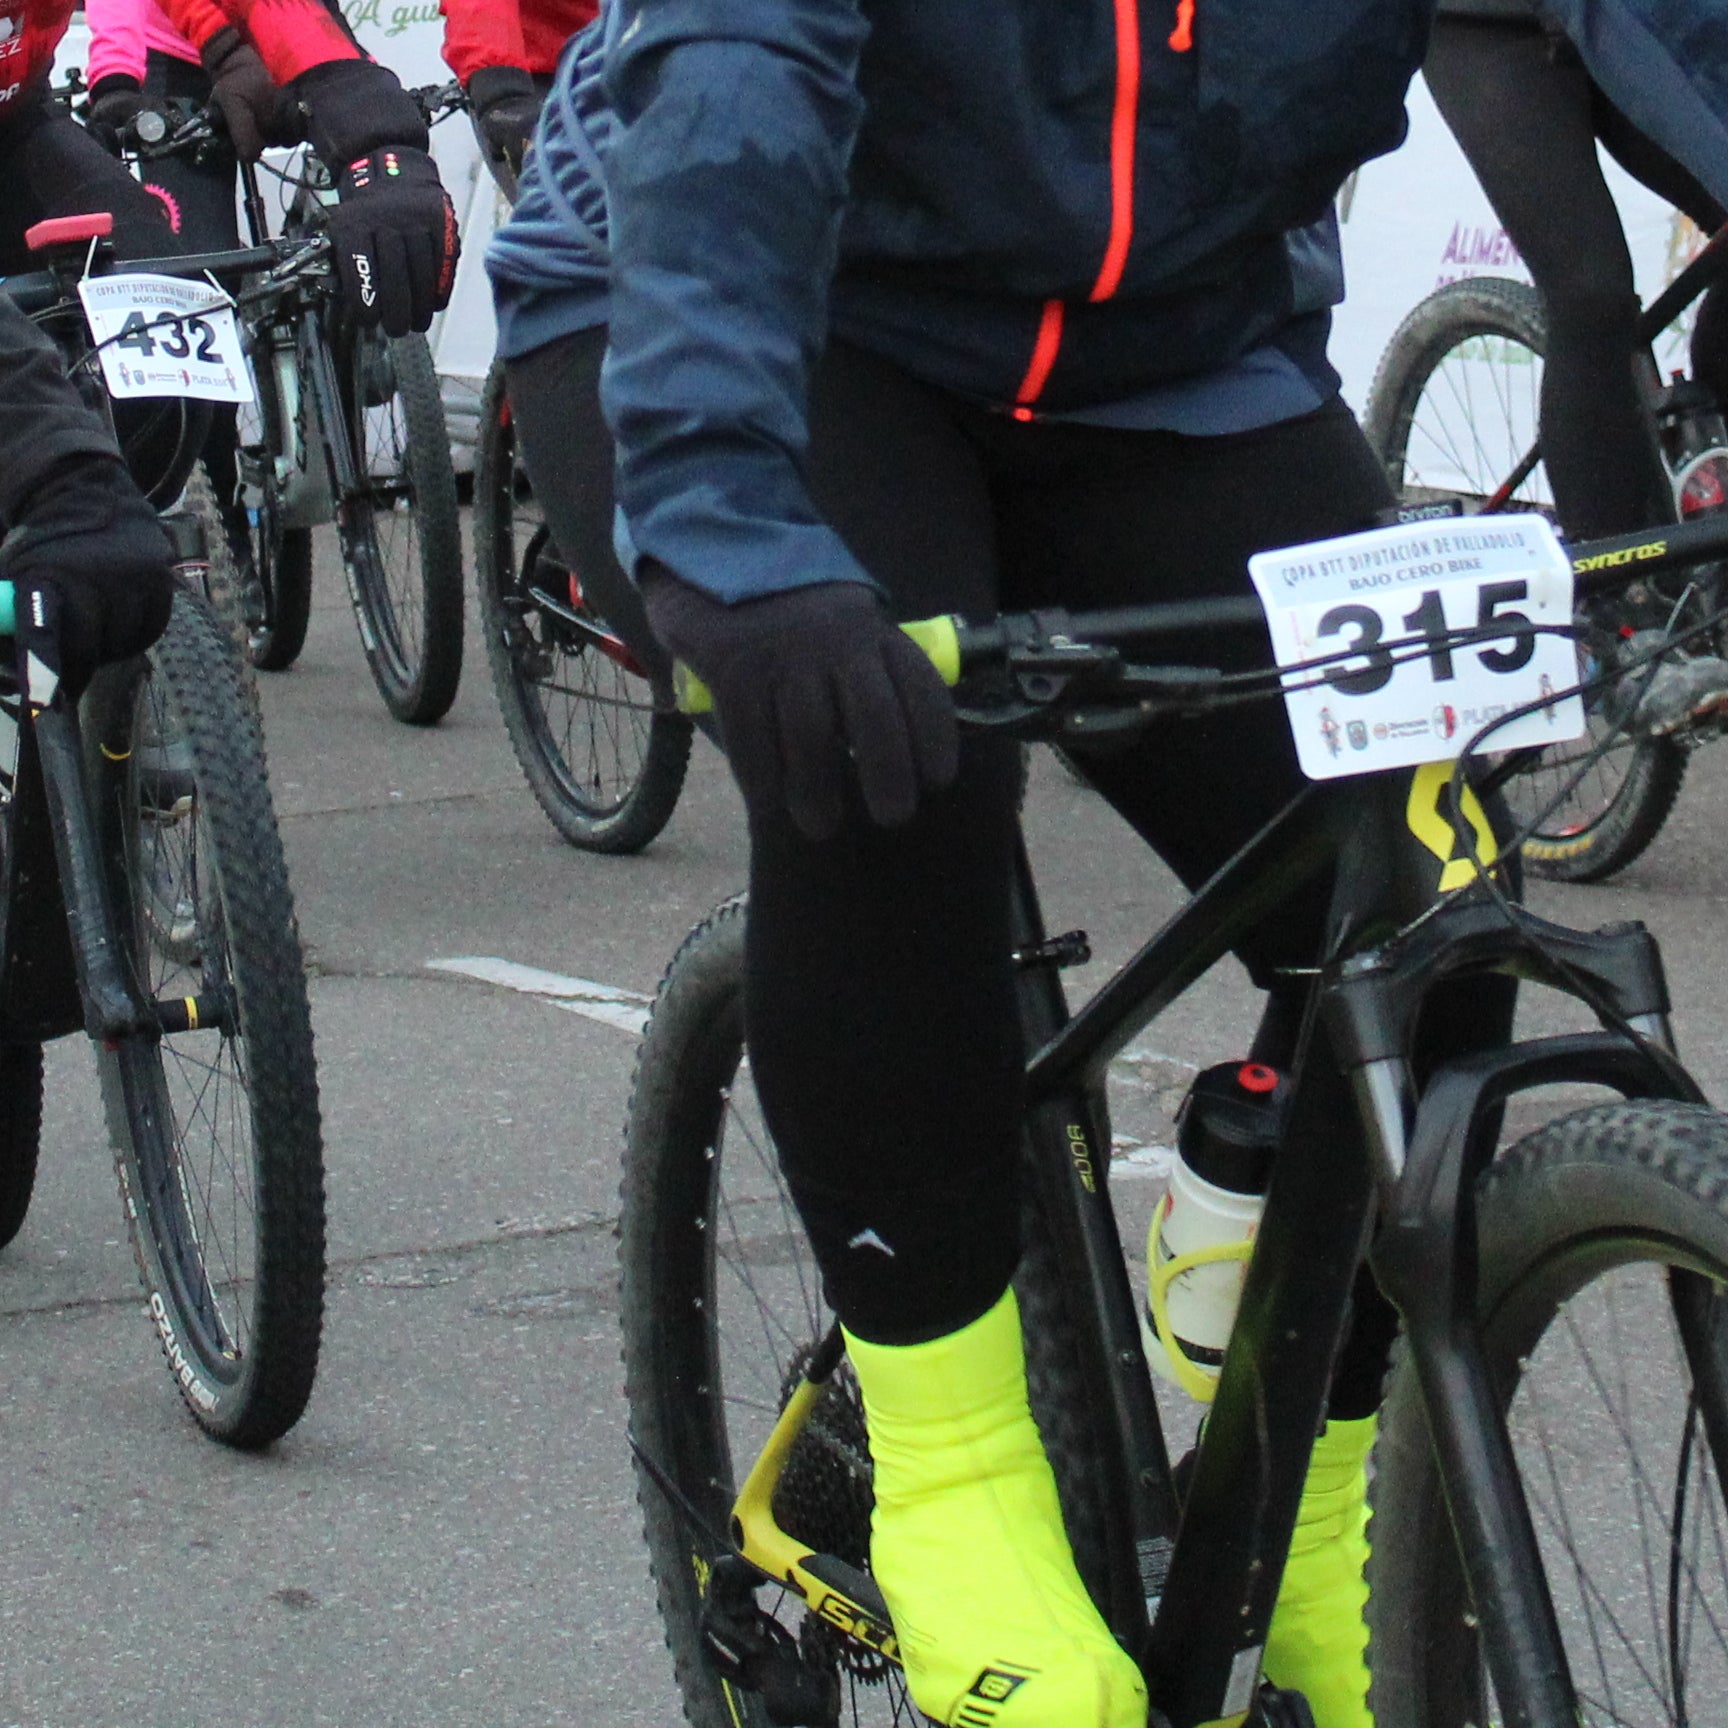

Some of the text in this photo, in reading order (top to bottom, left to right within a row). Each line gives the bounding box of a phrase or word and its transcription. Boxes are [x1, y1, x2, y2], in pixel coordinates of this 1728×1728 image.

[116, 310, 225, 365] 432
[1280, 562, 1319, 586] COPA
[1433, 537, 1451, 554] DE
[1348, 556, 1484, 592] BAJO CERO BIKE
[1572, 539, 1668, 574] syncros
[1316, 578, 1538, 697] 315
